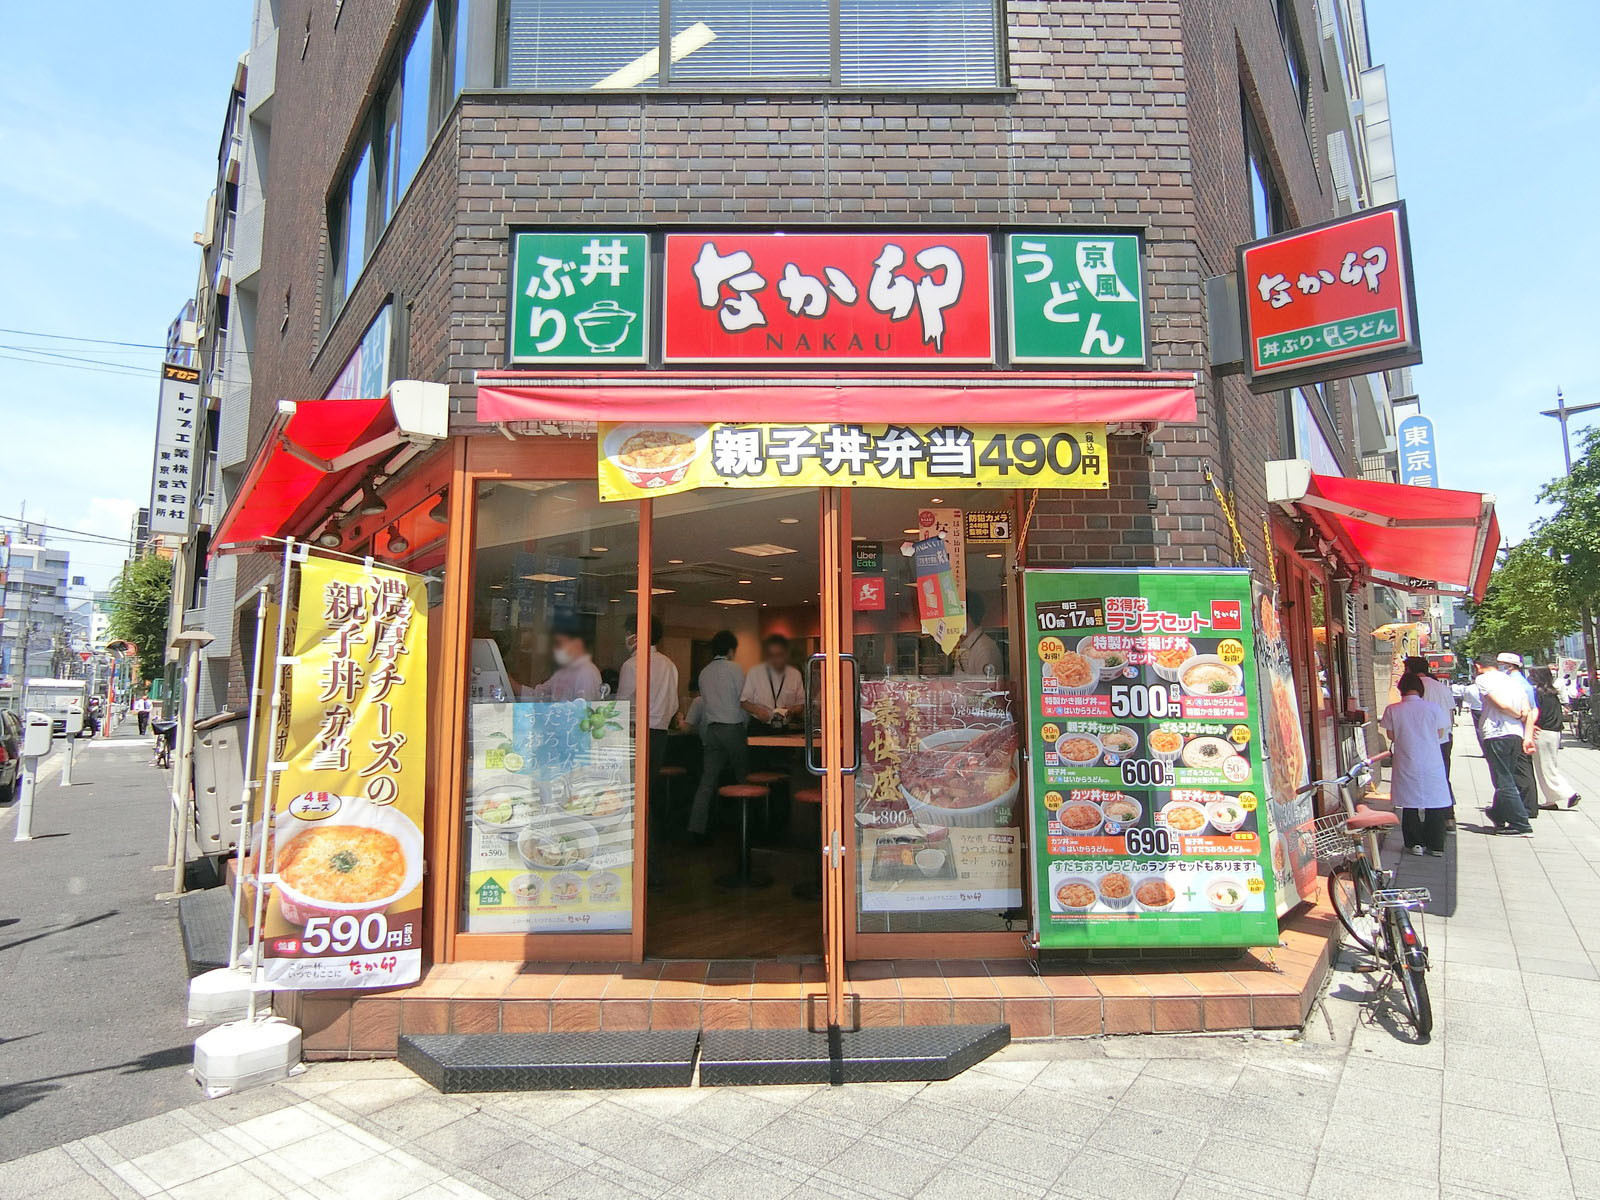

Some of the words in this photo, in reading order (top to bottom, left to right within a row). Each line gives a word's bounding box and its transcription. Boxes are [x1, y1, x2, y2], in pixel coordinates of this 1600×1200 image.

[1082, 244, 1121, 298] 京風
[1257, 246, 1389, 310] なか卯
[693, 241, 966, 354] なか卯
[1016, 240, 1126, 355] うどん
[765, 332, 894, 353] NAKAU
[166, 367, 199, 382] TOP
[168, 391, 194, 520] トップ工業株式会社
[713, 428, 976, 479] 親子丼弁当
[976, 432, 1101, 477] 490円
[155, 451, 171, 517] 東京営業所
[968, 513, 1009, 523] 防犯カメラ
[856, 551, 877, 559] Uber
[856, 559, 877, 567] Eats
[1106, 597, 1147, 612] お得な
[1106, 611, 1210, 632] ランチセット
[1041, 640, 1063, 651] 80円
[1093, 636, 1189, 651] 特製かき揚げ丼
[1220, 643, 1243, 654] 120円
[1127, 651, 1157, 665] セット
[313, 581, 368, 771] 親子丼弁当
[358, 575, 413, 806] 濃厚チーズの
[1110, 684, 1182, 718] 500円
[1043, 726, 1059, 734] 90円
[1121, 760, 1175, 786] 600円
[1071, 789, 1125, 801] カツ丼セット
[301, 802, 331, 813] チーズ
[1126, 829, 1180, 855] 690円
[302, 912, 403, 954] 590円
[349, 955, 398, 976] なか卯
